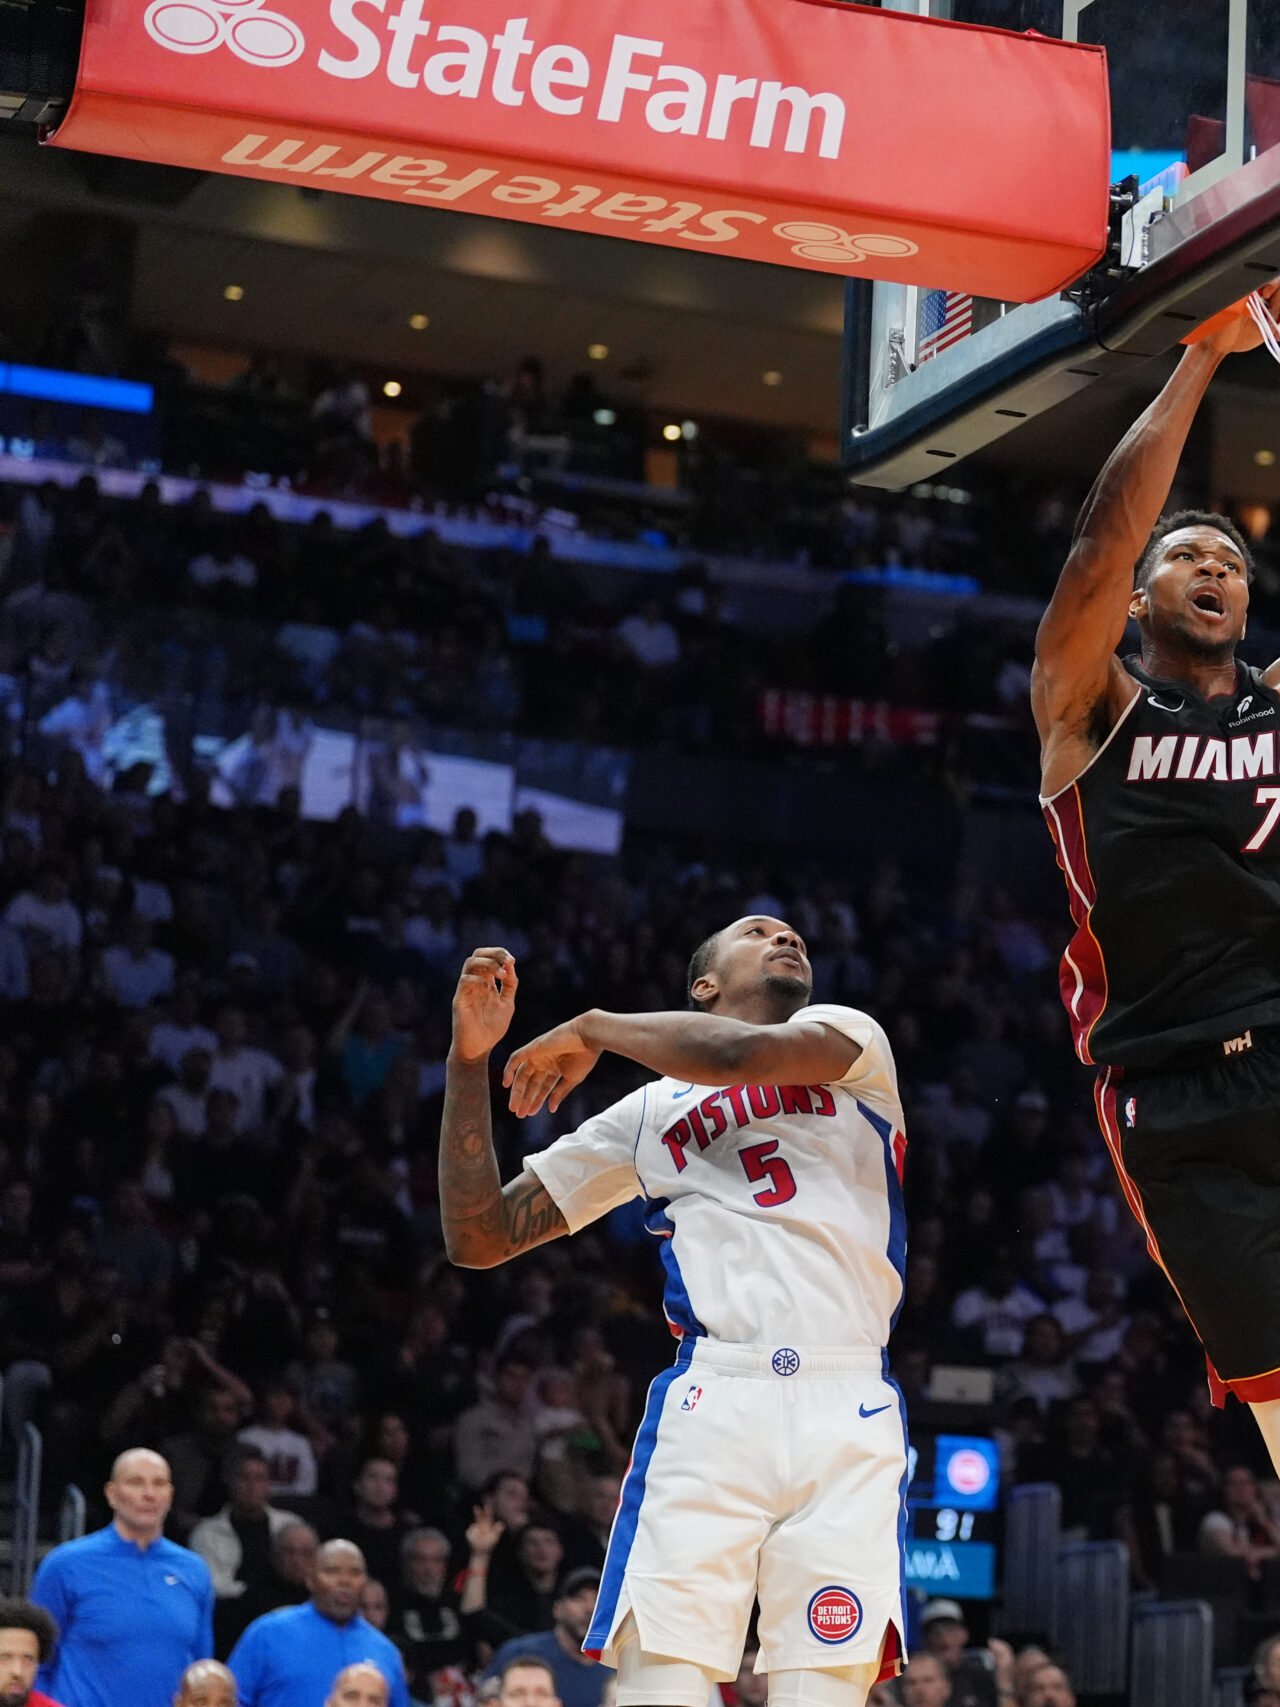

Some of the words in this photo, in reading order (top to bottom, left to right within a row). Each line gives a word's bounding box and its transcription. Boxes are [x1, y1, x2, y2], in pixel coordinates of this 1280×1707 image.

[1228, 707, 1275, 728] Robinhood
[661, 1085, 837, 1174] PISTONS
[738, 1139, 797, 1208] 5
[935, 1508, 975, 1541] 91
[817, 1605, 852, 1615] DETROIT
[817, 1615, 852, 1625] PISTONS
